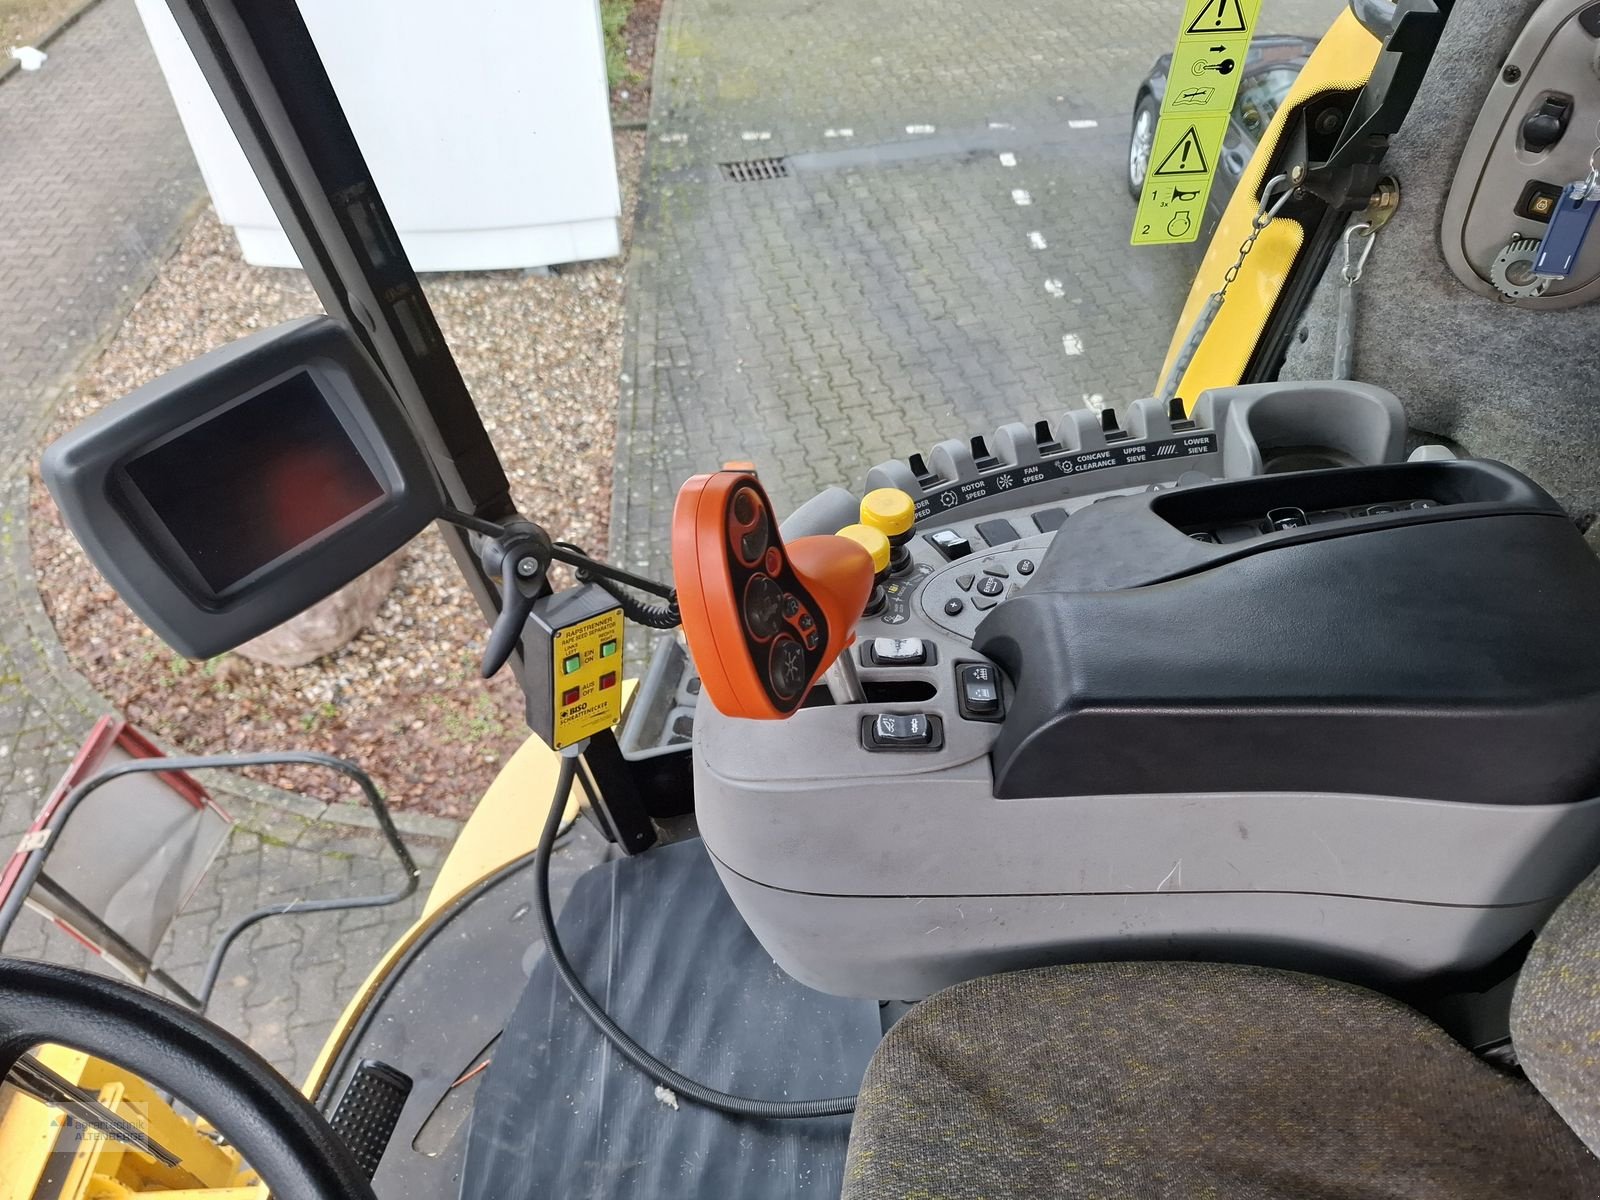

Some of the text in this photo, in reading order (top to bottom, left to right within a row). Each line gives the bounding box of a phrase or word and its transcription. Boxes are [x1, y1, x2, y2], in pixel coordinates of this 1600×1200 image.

[1152, 190, 1158, 200] 1
[1142, 224, 1150, 234] 2
[1183, 437, 1210, 446] LOWER
[1123, 446, 1146, 455] UPPER
[1188, 446, 1208, 454] SIEVE
[1077, 451, 1110, 462] CONCAVE
[1126, 454, 1146, 463] SIEVE
[1024, 466, 1039, 475] FAN
[1075, 459, 1116, 472] CLEARANCE
[1022, 473, 1044, 484] SPEED
[961, 481, 985, 492] ROTOR
[965, 489, 986, 500] SPEED
[914, 508, 931, 519] PEED
[584, 648, 594, 658] EIN
[584, 656, 594, 664] ON
[582, 681, 594, 690] AUS
[582, 688, 594, 696] OFF
[570, 702, 588, 716] BISO
